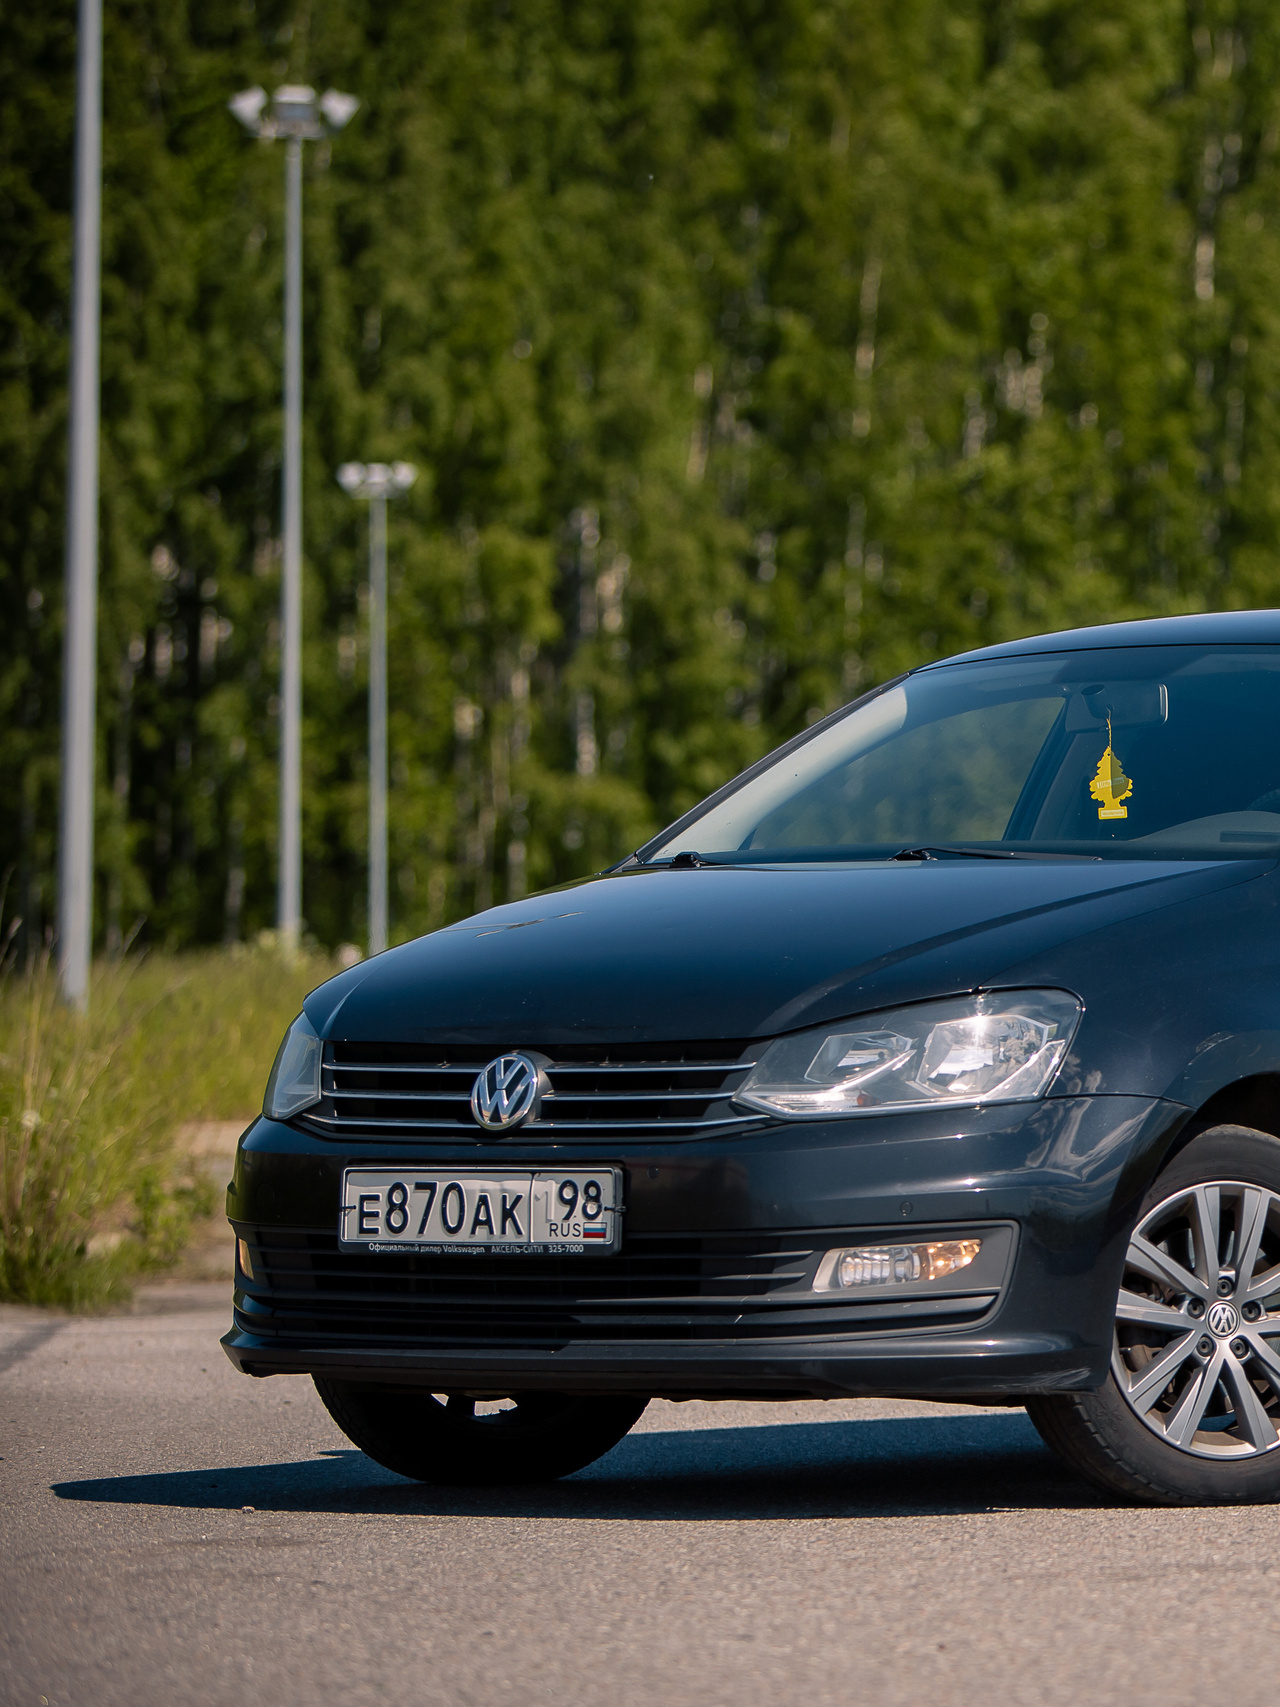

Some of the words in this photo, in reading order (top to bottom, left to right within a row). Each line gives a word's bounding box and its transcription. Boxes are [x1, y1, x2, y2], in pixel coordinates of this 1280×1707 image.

[476, 1056, 534, 1127] VW
[549, 1222, 581, 1238] RUS
[368, 1243, 419, 1253] Официальный
[420, 1245, 442, 1254] дилер
[442, 1245, 485, 1254] Volkswagen
[491, 1245, 544, 1253] АКСЕЛЬ-СИТИ
[548, 1244, 584, 1253] 325-7000
